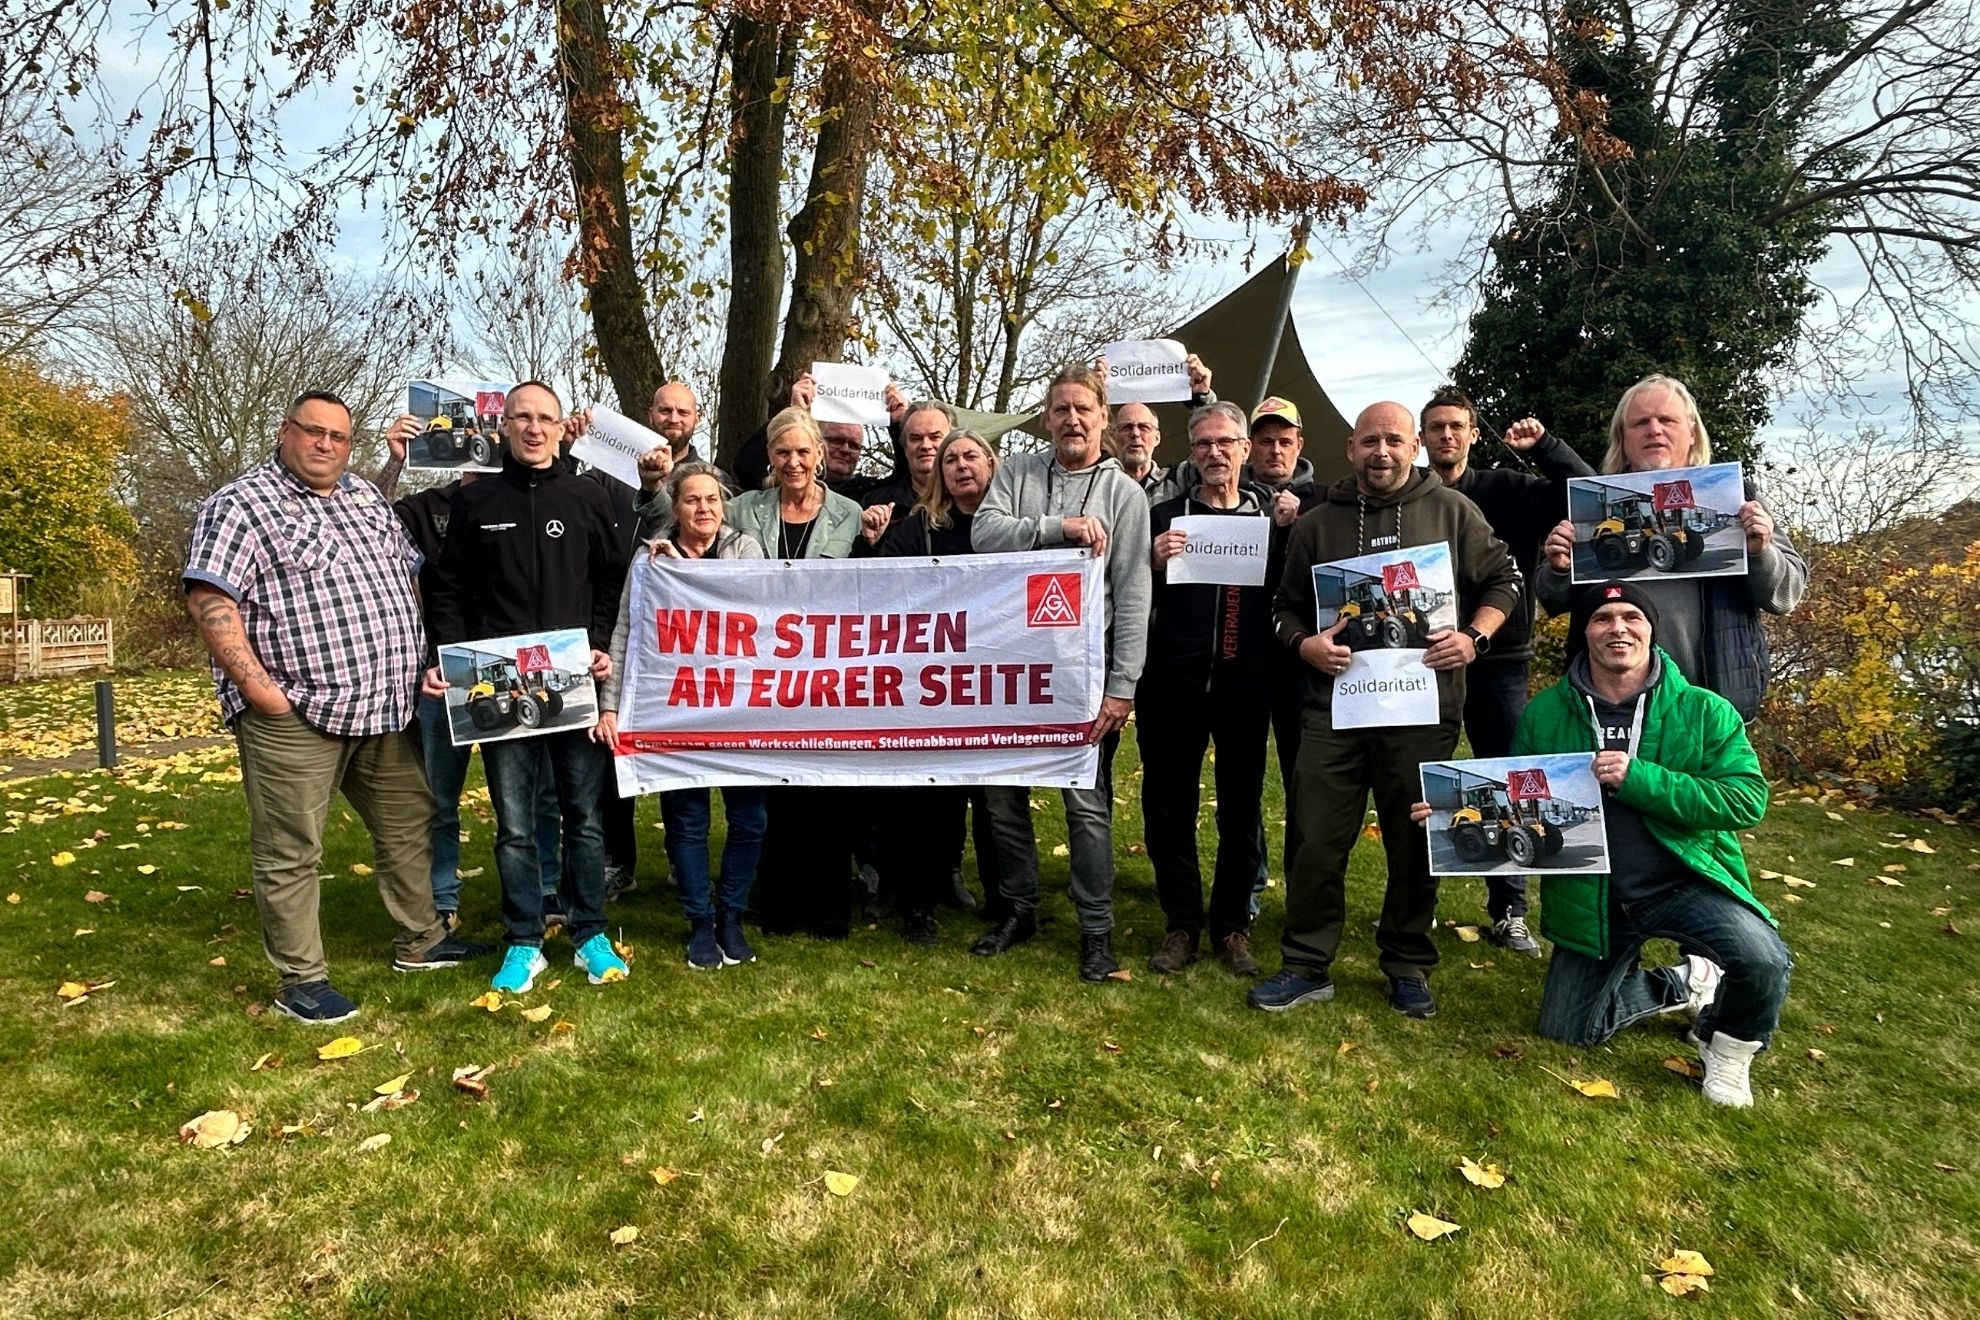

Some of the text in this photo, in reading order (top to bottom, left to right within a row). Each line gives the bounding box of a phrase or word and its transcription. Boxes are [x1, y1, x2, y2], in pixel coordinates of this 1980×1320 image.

[1110, 362, 1184, 378] Solidarität!
[1184, 541, 1259, 557] olidarität!
[656, 608, 967, 659] WIR STEHEN
[667, 663, 1054, 708] AN EURER SEITE
[1339, 677, 1428, 696] Solidarität!
[749, 737, 876, 751] Werksschließungen,
[879, 734, 962, 749] Stellenabbau
[965, 733, 988, 746] und
[991, 731, 1084, 747] Verlagerungen
